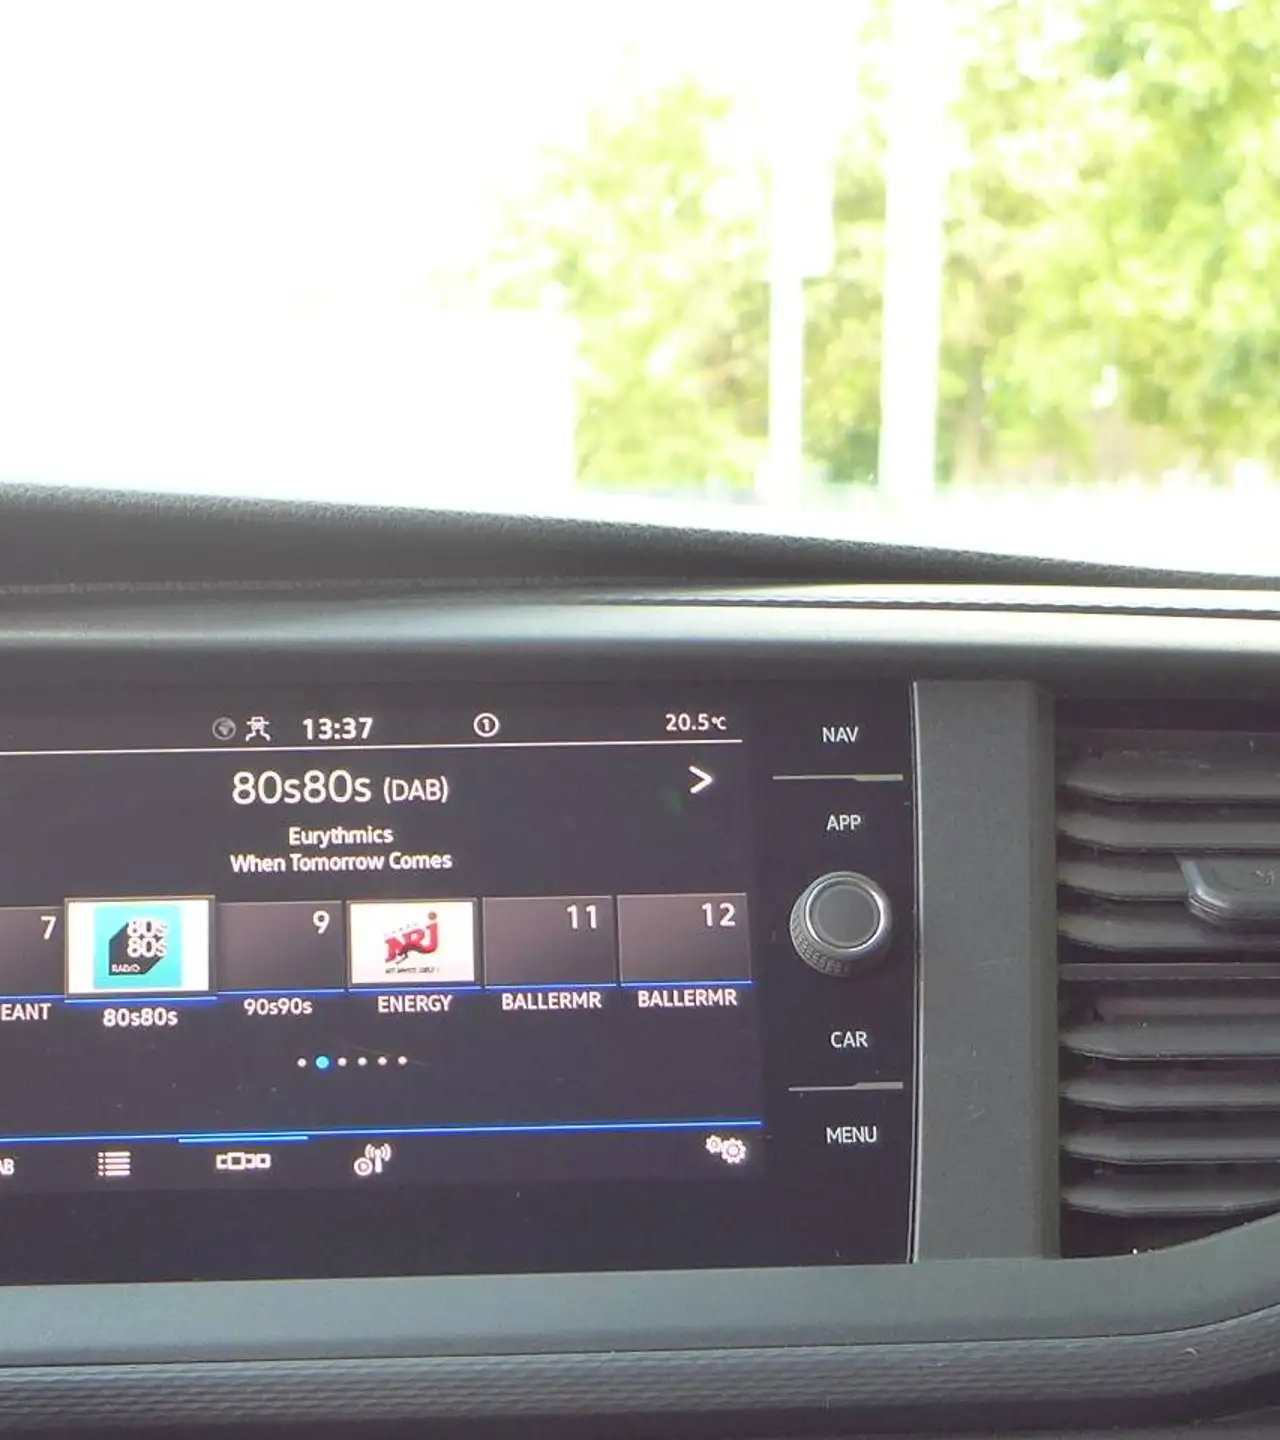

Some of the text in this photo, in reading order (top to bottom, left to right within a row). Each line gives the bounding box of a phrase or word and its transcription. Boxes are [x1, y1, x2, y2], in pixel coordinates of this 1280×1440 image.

[302, 717, 373, 740] 13:37
[822, 727, 859, 743] NAV
[231, 769, 449, 805] 80s80s (DAB)
[826, 815, 861, 831] APP
[288, 825, 394, 848] Eurythmics
[230, 852, 453, 873] When Tomorrow Comes
[313, 912, 329, 935] 9
[567, 905, 597, 930] 11
[702, 903, 736, 928] 12
[41, 916, 55, 940] 7
[126, 918, 168, 937] 80s
[126, 937, 167, 958] 80s
[243, 998, 313, 1016] 90s90s
[377, 995, 452, 1012] ENERGY
[501, 992, 602, 1011] BALLERMR
[637, 990, 737, 1008] BALLERMR
[102, 1007, 179, 1028] 80s80s
[830, 1031, 868, 1048] CAR
[826, 1127, 877, 1144] MENU
